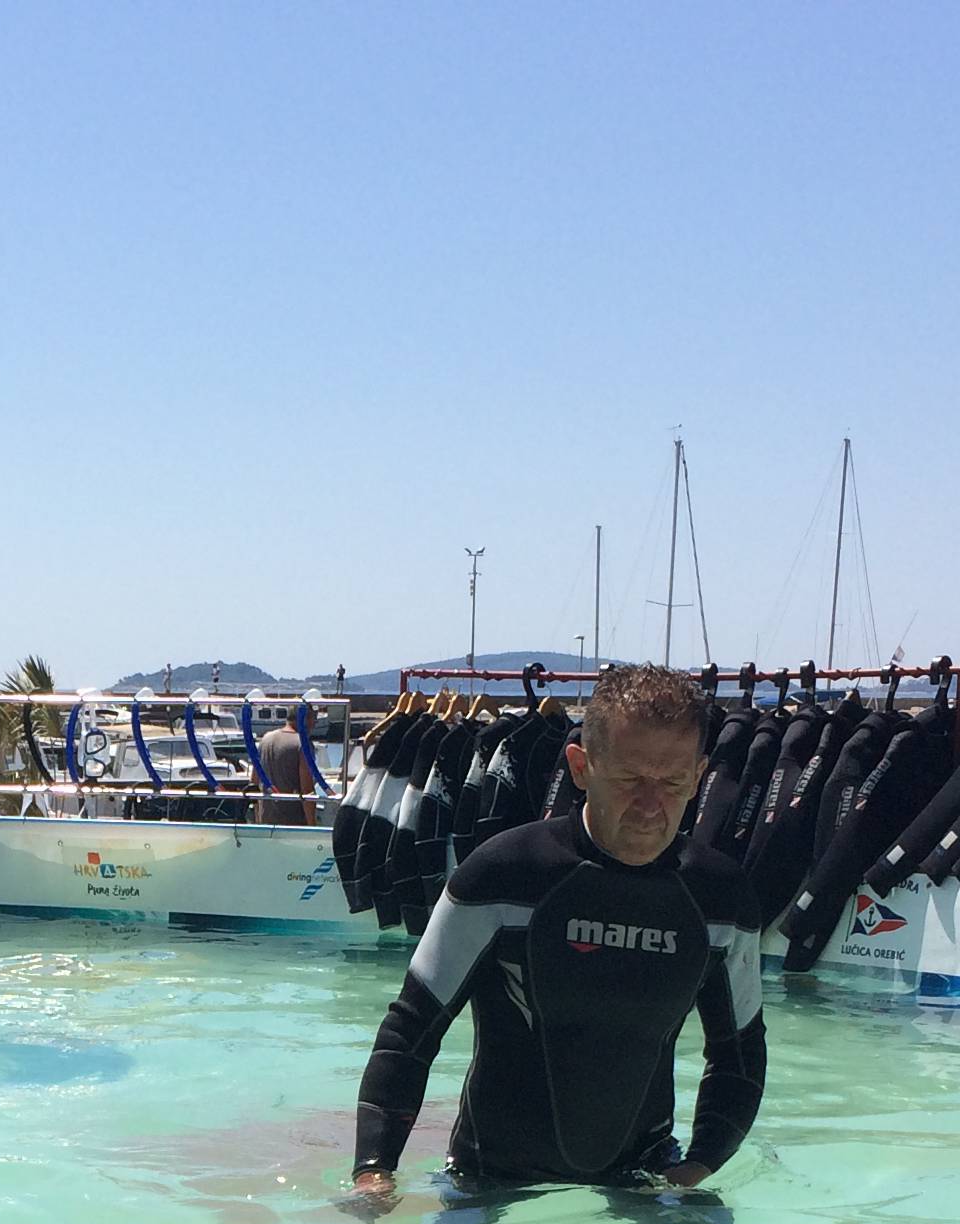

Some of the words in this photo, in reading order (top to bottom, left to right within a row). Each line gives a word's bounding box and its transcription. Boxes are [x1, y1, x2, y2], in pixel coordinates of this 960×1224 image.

[547, 768, 566, 806] mares
[767, 768, 785, 807] mares
[795, 754, 823, 793] mares
[73, 863, 152, 879] HRVATSKA
[566, 918, 678, 954] mares
[840, 943, 871, 958] LUČICA
[873, 947, 906, 960] OREBIĆ
